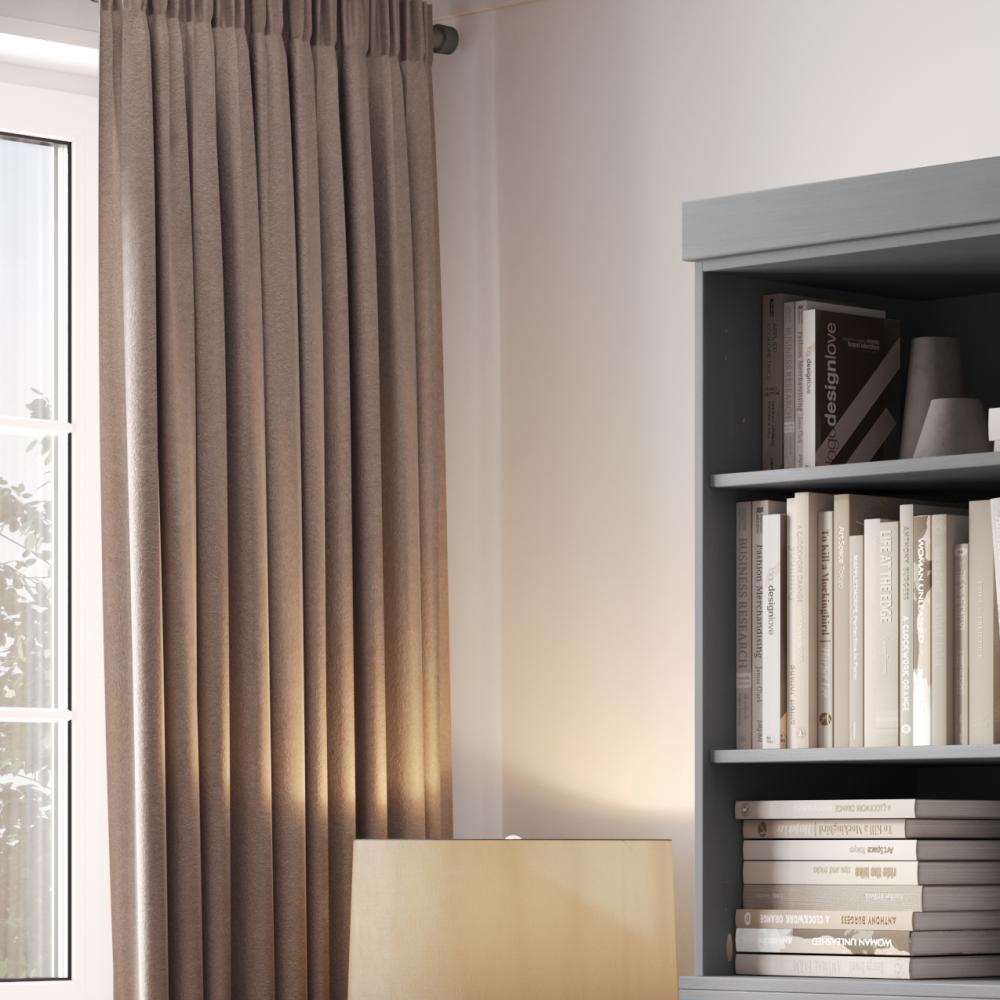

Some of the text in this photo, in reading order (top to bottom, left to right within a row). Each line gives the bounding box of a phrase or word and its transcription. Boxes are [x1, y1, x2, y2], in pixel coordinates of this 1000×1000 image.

[880, 530, 891, 623] LIFE AT THE EDGE
[785, 914, 823, 924] CLOCKWORK
[841, 915, 866, 925] BURGESS
[868, 916, 896, 925] ANTHONY
